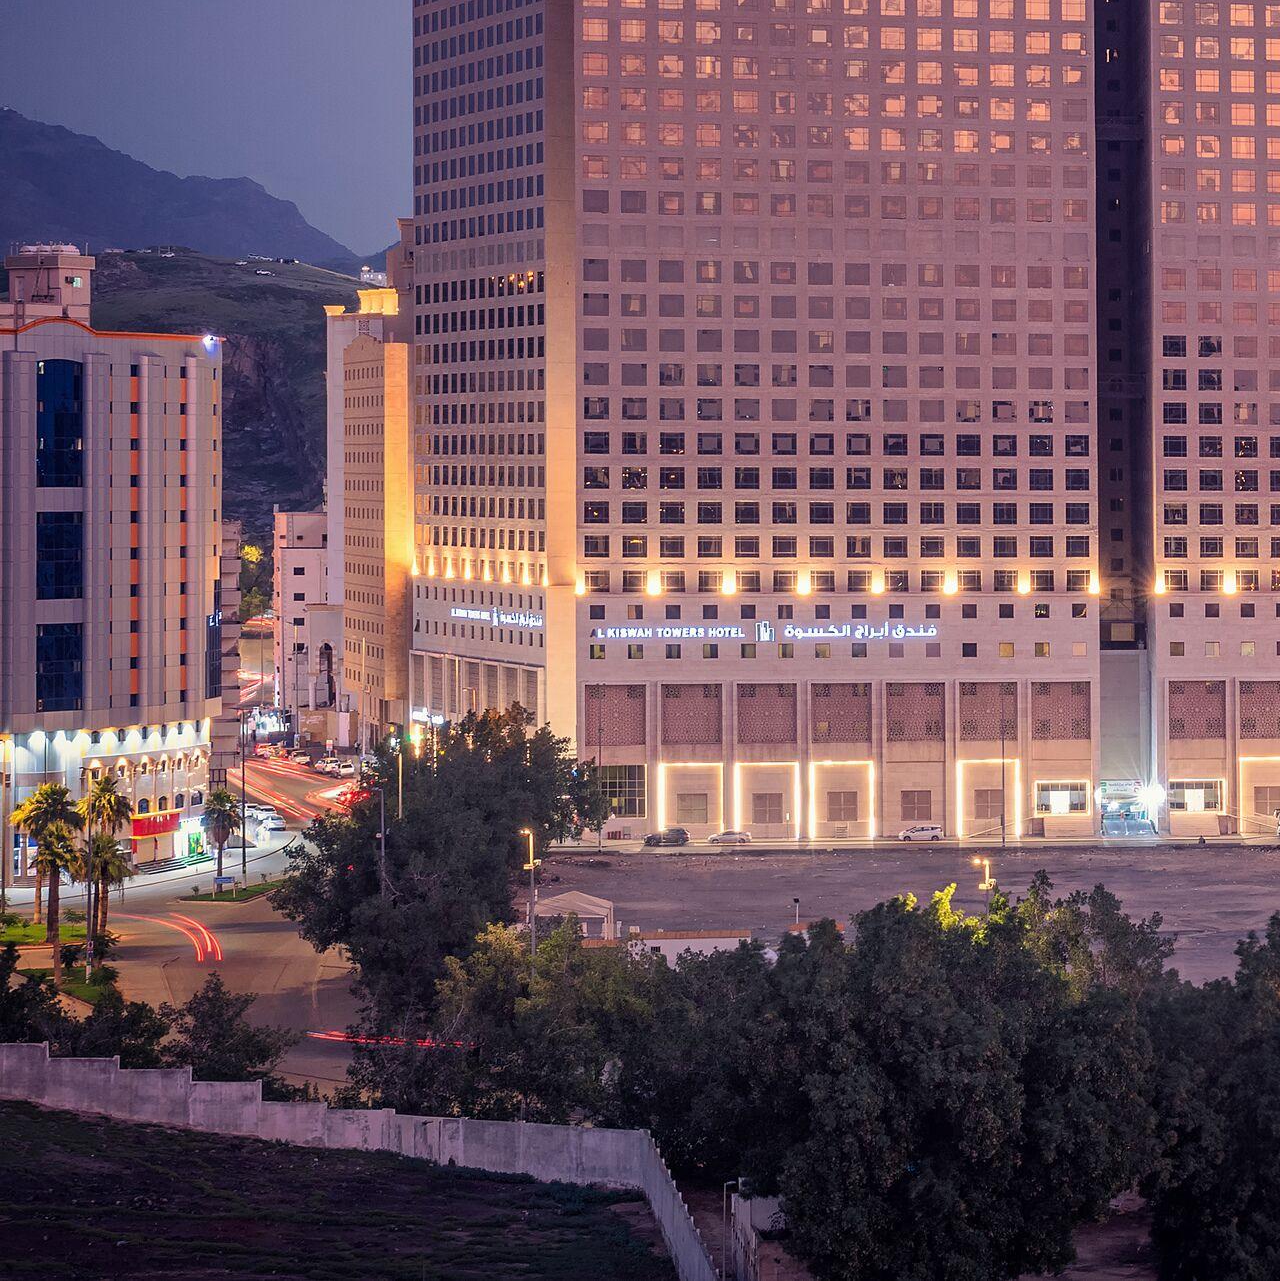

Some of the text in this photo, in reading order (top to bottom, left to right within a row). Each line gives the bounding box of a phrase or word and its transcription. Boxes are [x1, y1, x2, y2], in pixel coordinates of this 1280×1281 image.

[607, 628, 653, 638] KISWAH
[655, 628, 705, 638] TOWERS
[708, 628, 745, 638] HOTEL
[784, 621, 937, 639] فندق أبراج الكسوة
